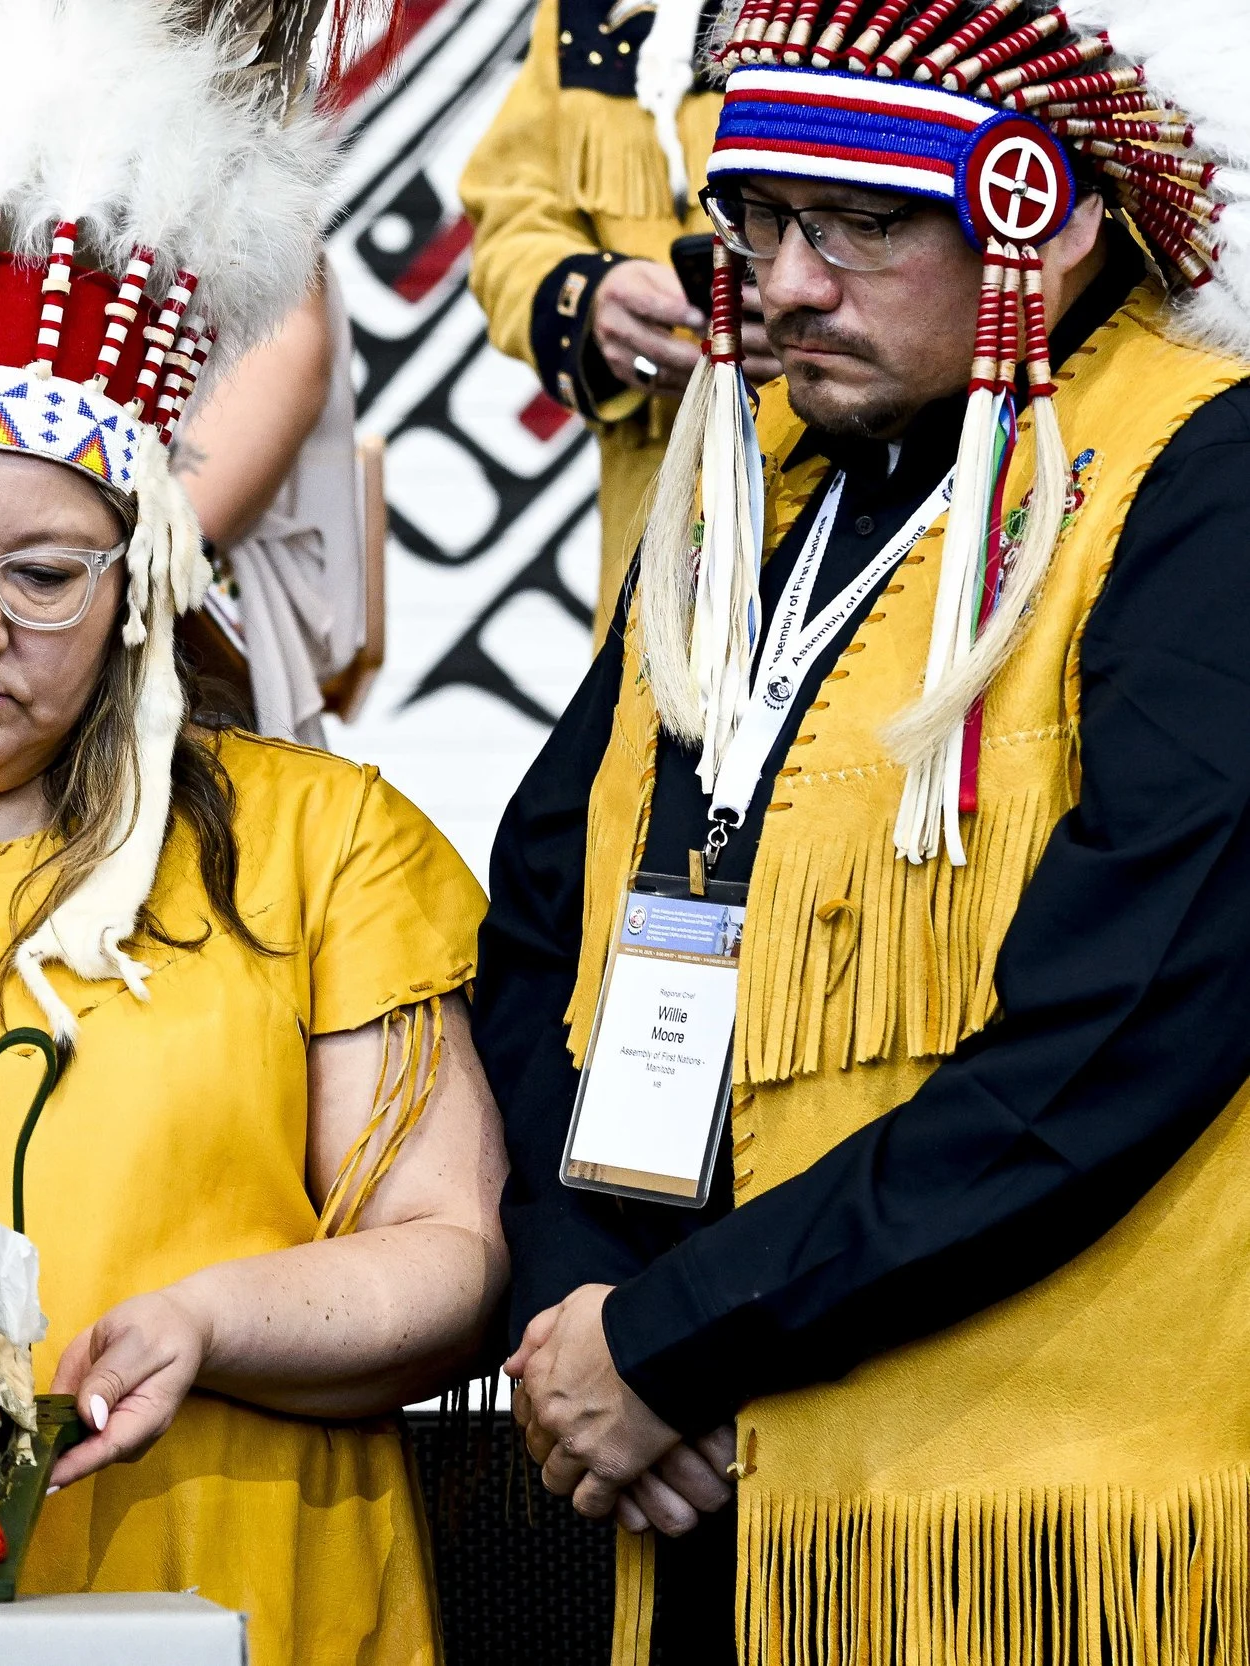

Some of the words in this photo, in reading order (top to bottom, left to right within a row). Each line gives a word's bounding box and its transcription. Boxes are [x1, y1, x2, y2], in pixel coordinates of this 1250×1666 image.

[807, 516, 828, 565] Nations
[793, 564, 811, 592] First
[790, 595, 800, 607] of
[792, 611, 846, 667] Assembly
[846, 596, 858, 608] of
[857, 568, 881, 594] First
[883, 524, 927, 564] Nations
[769, 610, 797, 670] ssembly
[658, 1006, 688, 1024] Willie
[651, 1026, 685, 1044] Moore
[620, 1046, 652, 1059] Assembly
[653, 1051, 661, 1059] of
[661, 1052, 676, 1062] First
[677, 1054, 701, 1066] Nations
[646, 1063, 676, 1075] Manitoba
